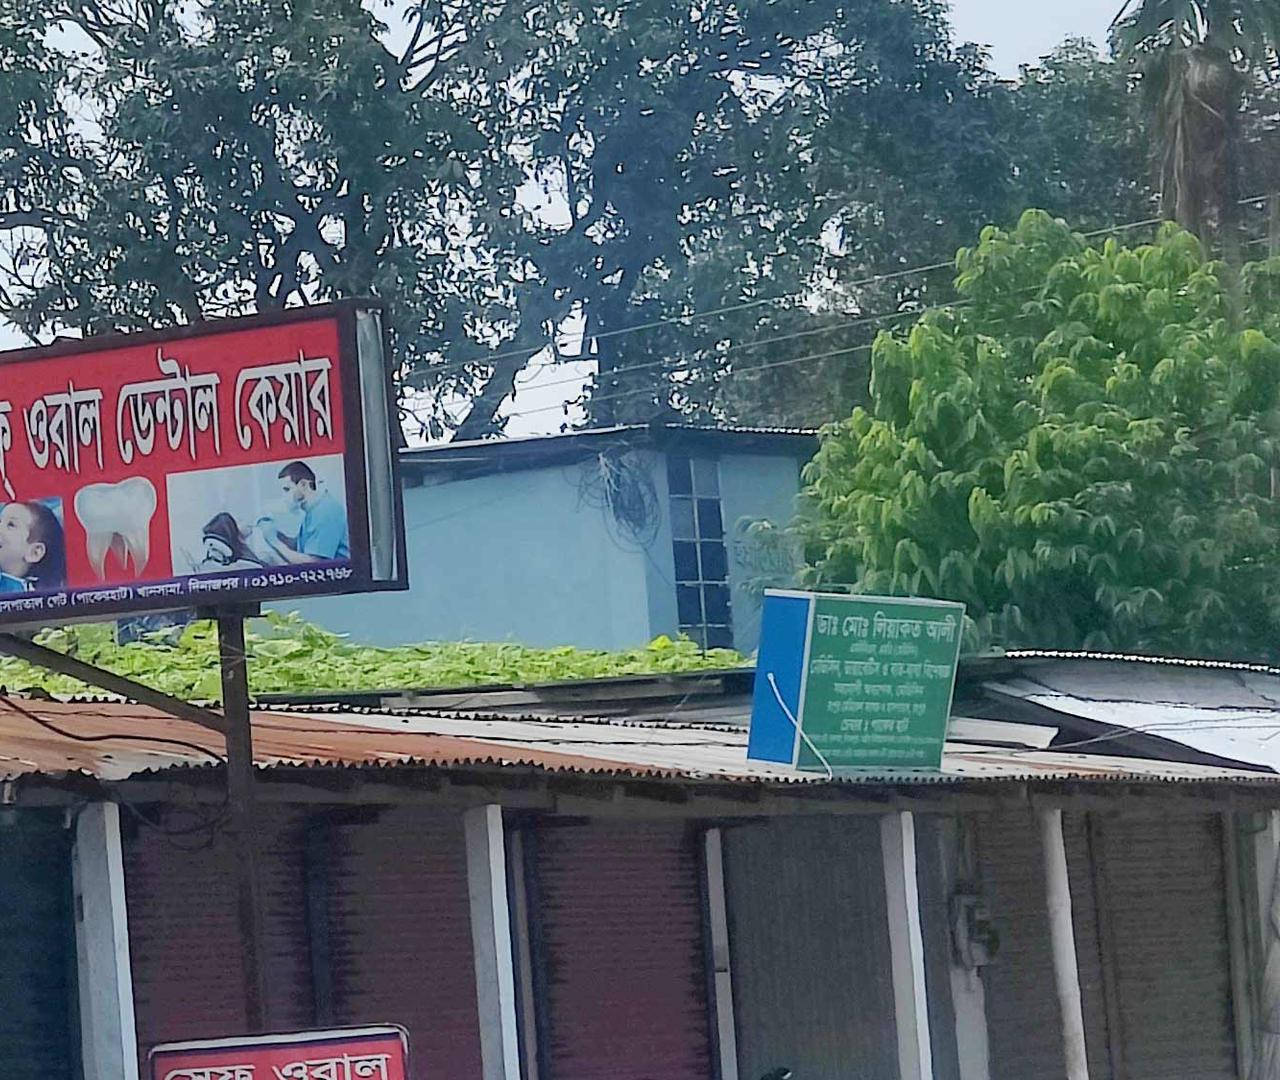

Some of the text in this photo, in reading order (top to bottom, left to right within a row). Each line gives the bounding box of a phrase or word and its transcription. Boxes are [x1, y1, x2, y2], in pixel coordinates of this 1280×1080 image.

[23, 379, 104, 474] ওরাল
[116, 347, 221, 465] ডেন্টাল
[235, 348, 334, 451] কেয়ার
[251, 568, 353, 588] ০১৭১০-৭২২৭৬৮
[842, 616, 869, 638] মোঃ
[926, 614, 957, 642] আলী
